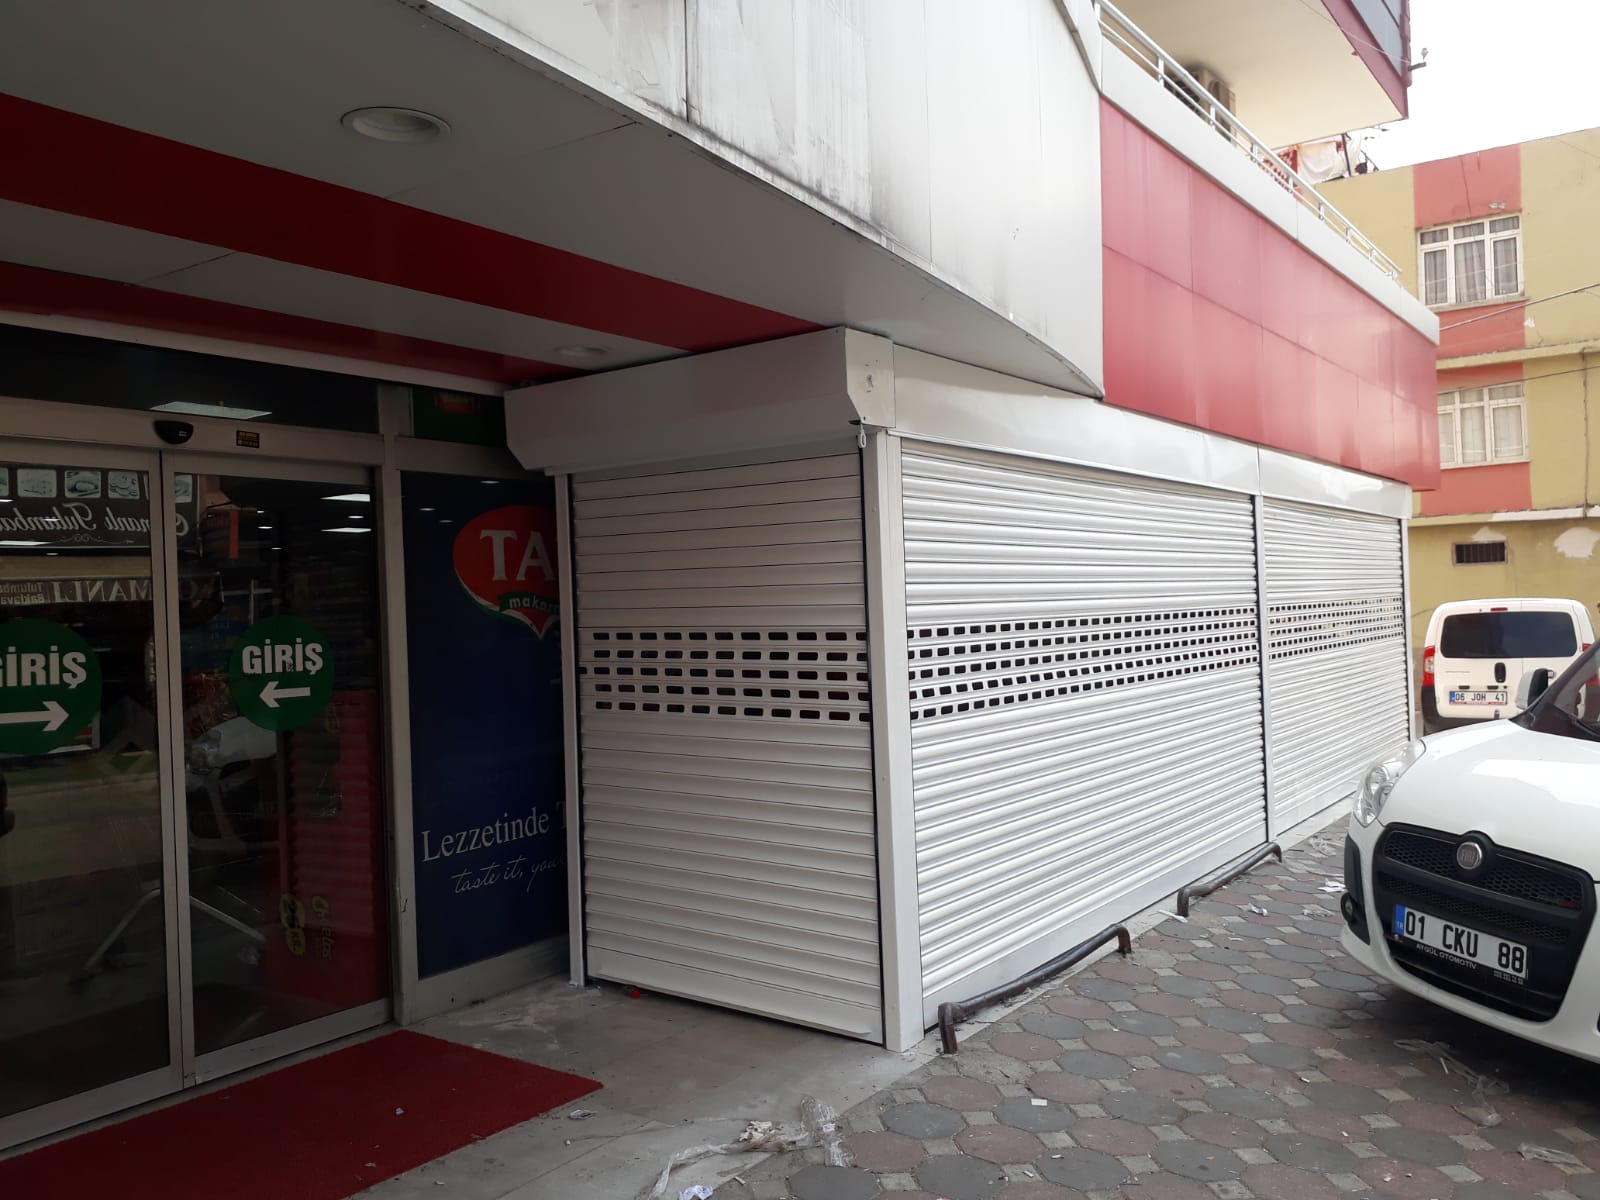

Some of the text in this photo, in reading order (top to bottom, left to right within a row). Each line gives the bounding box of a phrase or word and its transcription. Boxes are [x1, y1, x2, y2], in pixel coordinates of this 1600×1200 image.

[480, 529, 557, 582] TA
[0, 645, 87, 689] İRİŞ
[242, 637, 324, 675] GİRİŞ
[1455, 692, 1465, 701] 06
[1495, 692, 1505, 702] 41
[421, 806, 550, 862] Lezzetinde
[451, 862, 501, 893] taste
[1405, 911, 1524, 973] 01 CKU 88
